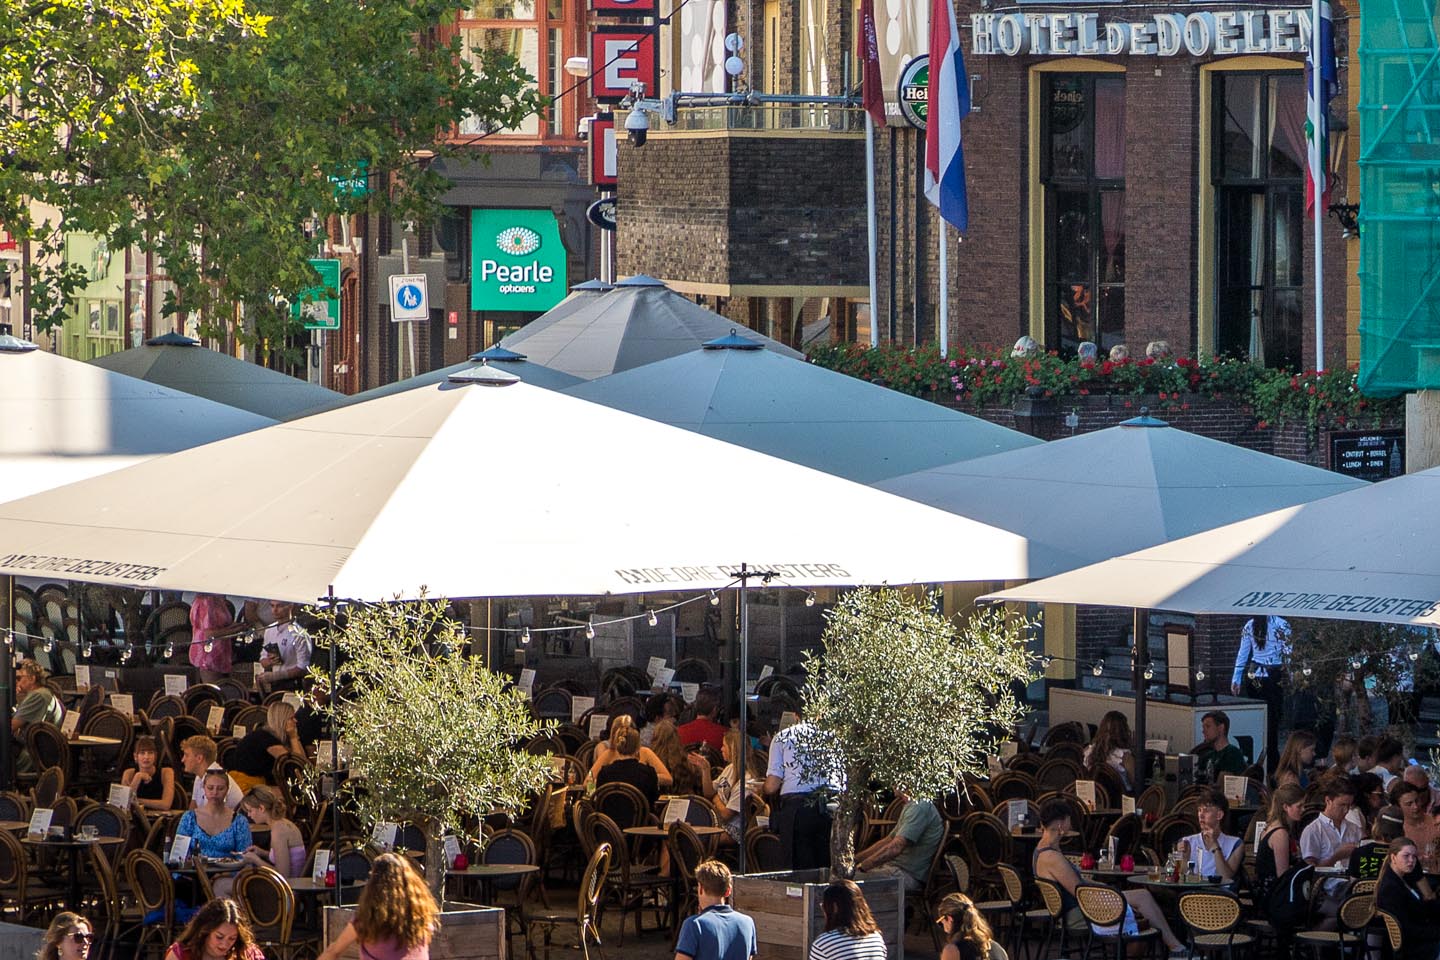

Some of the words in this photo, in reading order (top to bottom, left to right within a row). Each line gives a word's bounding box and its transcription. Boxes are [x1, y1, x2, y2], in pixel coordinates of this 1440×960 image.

[972, 13, 1099, 57] HOTEL
[481, 259, 554, 283] Pearle
[499, 284, 536, 295] opticiens
[64, 559, 169, 581] GEZUSTERS
[642, 567, 675, 583] DE
[670, 565, 721, 581] DRIE
[1260, 592, 1293, 608] DE
[1282, 593, 1337, 611] DRIE
